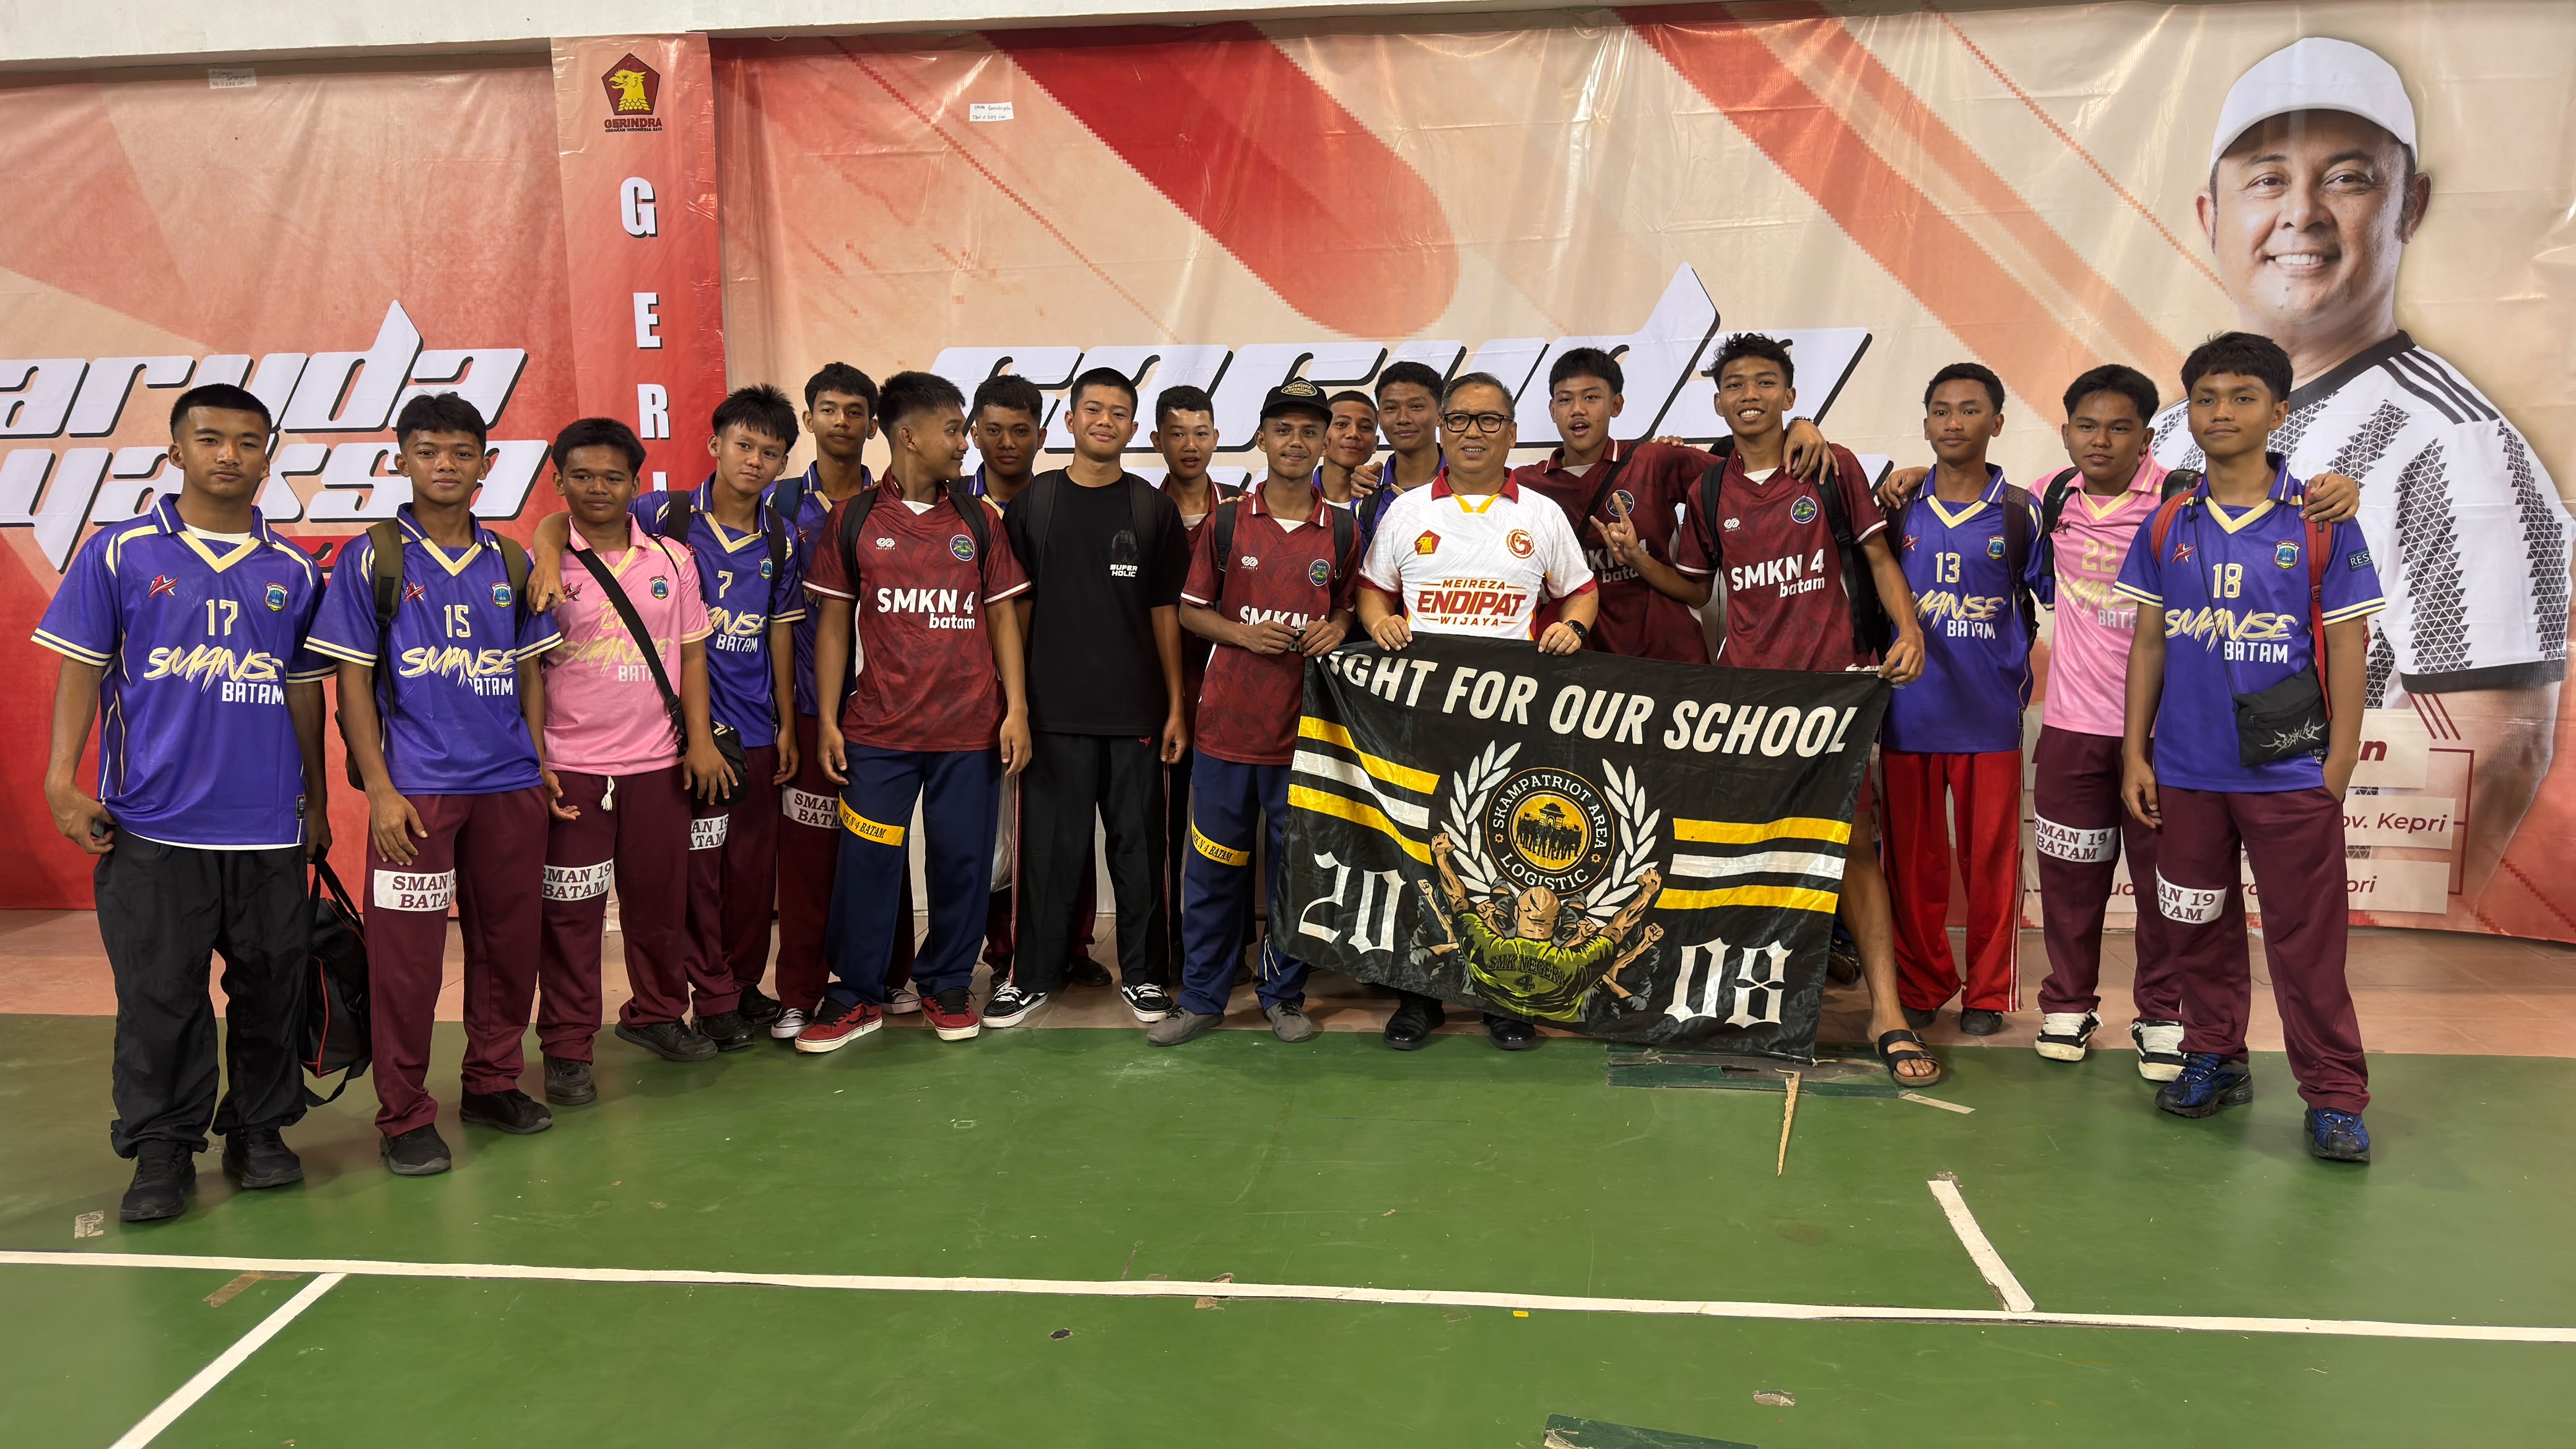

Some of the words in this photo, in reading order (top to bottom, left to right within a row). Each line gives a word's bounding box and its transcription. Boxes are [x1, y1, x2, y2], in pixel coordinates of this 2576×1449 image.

[604, 118, 662, 128] GERINDRA
[1936, 552, 1960, 583] 13
[2081, 539, 2117, 573] 22
[2351, 553, 2372, 566] RES
[1602, 567, 1640, 583] bata
[1731, 554, 1803, 591] SMKN
[1810, 549, 1824, 573] 4
[2213, 564, 2243, 599] 18
[718, 570, 733, 599] 7
[1442, 580, 1505, 590] MEIREZA
[1780, 577, 1825, 598] batam
[877, 588, 958, 613] SMKN
[964, 591, 975, 614] 4
[1417, 591, 1527, 616] ENDIPAT
[206, 599, 238, 636] 17
[444, 604, 471, 638] 15
[600, 600, 627, 630] 2
[929, 613, 975, 629] batam
[1440, 616, 1499, 626] WIJAYA
[716, 633, 758, 652] BATAM
[2224, 641, 2288, 664] BATAM
[221, 681, 284, 705] BATAM
[468, 677, 513, 695] ATAM
[1442, 666, 1538, 725] FOR
[1549, 685, 1655, 744] OUR
[1663, 700, 1858, 757] SCHOOL
[794, 793, 840, 812] SMAN
[1493, 775, 1591, 829] SKAMPATRIOT
[1588, 804, 1608, 848] AREA
[798, 808, 841, 826] BATA
[2377, 812, 2447, 833] Kepri
[859, 823, 887, 838] BATAM
[2035, 818, 2081, 844] SMAN
[2087, 832, 2107, 845] 19
[1208, 846, 1234, 861] BATAM
[2037, 834, 2098, 859] BATAM
[393, 875, 448, 890] SMAN
[542, 868, 591, 883] MAN
[597, 863, 611, 879] 19
[1500, 853, 1589, 890] LOGISTIC
[542, 880, 605, 899] BATAM
[2191, 892, 2216, 906] 19
[1299, 851, 1407, 954] 20
[1487, 954, 1517, 970] SMK
[1517, 955, 1565, 987] NEGERI
[1514, 973, 1535, 992] 4
[1664, 937, 1793, 1029] 08
